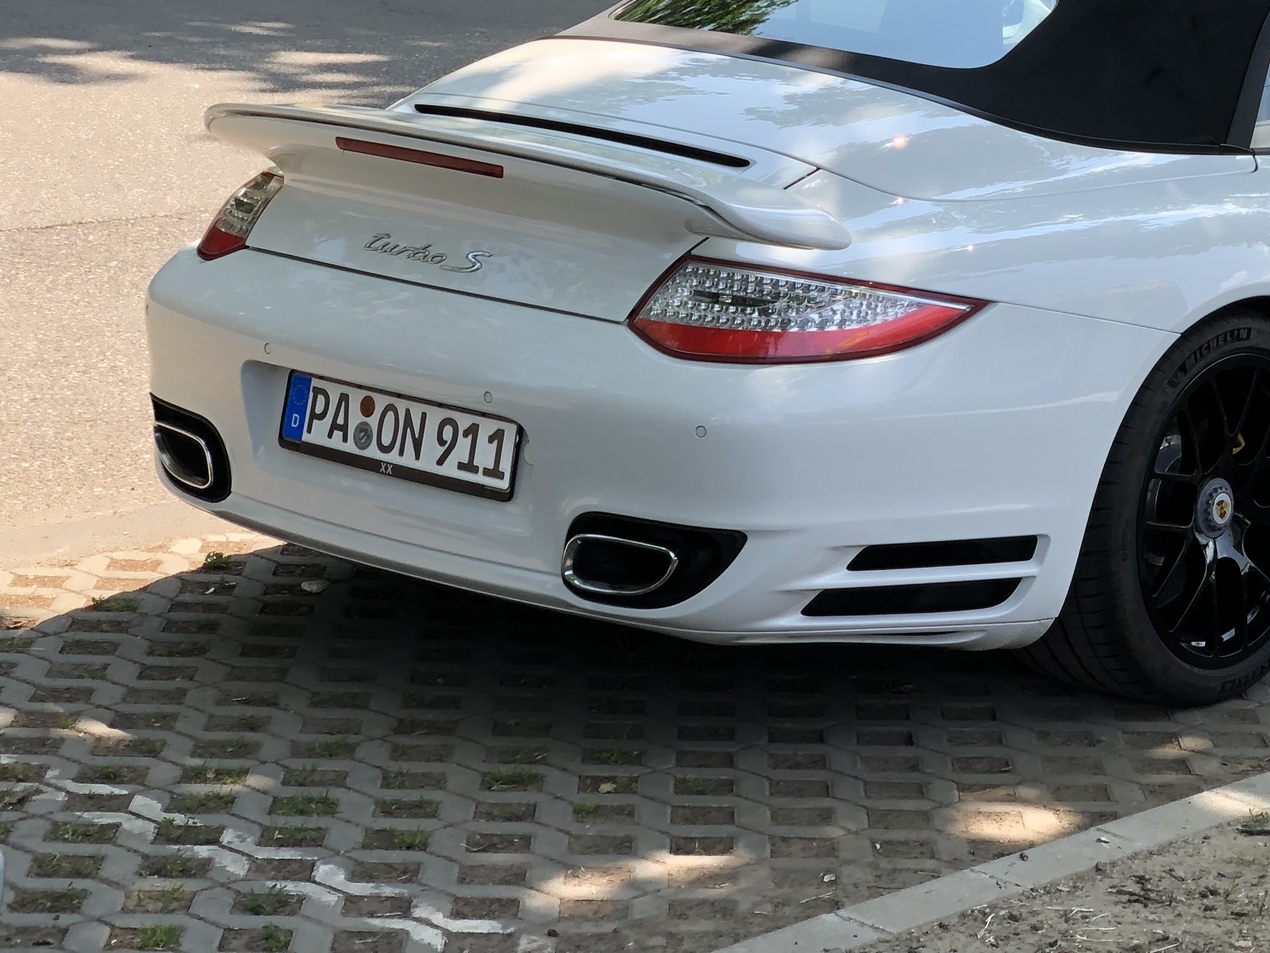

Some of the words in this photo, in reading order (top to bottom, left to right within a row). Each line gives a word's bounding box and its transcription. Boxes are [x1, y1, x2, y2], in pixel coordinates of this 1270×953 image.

[364, 232, 448, 265] turbo
[439, 250, 494, 274] S
[1184, 328, 1250, 369] MICHELIN
[291, 413, 300, 428] D
[305, 385, 350, 443] PA
[376, 403, 427, 461] ON
[435, 417, 506, 480] 911
[379, 462, 394, 475] XX
